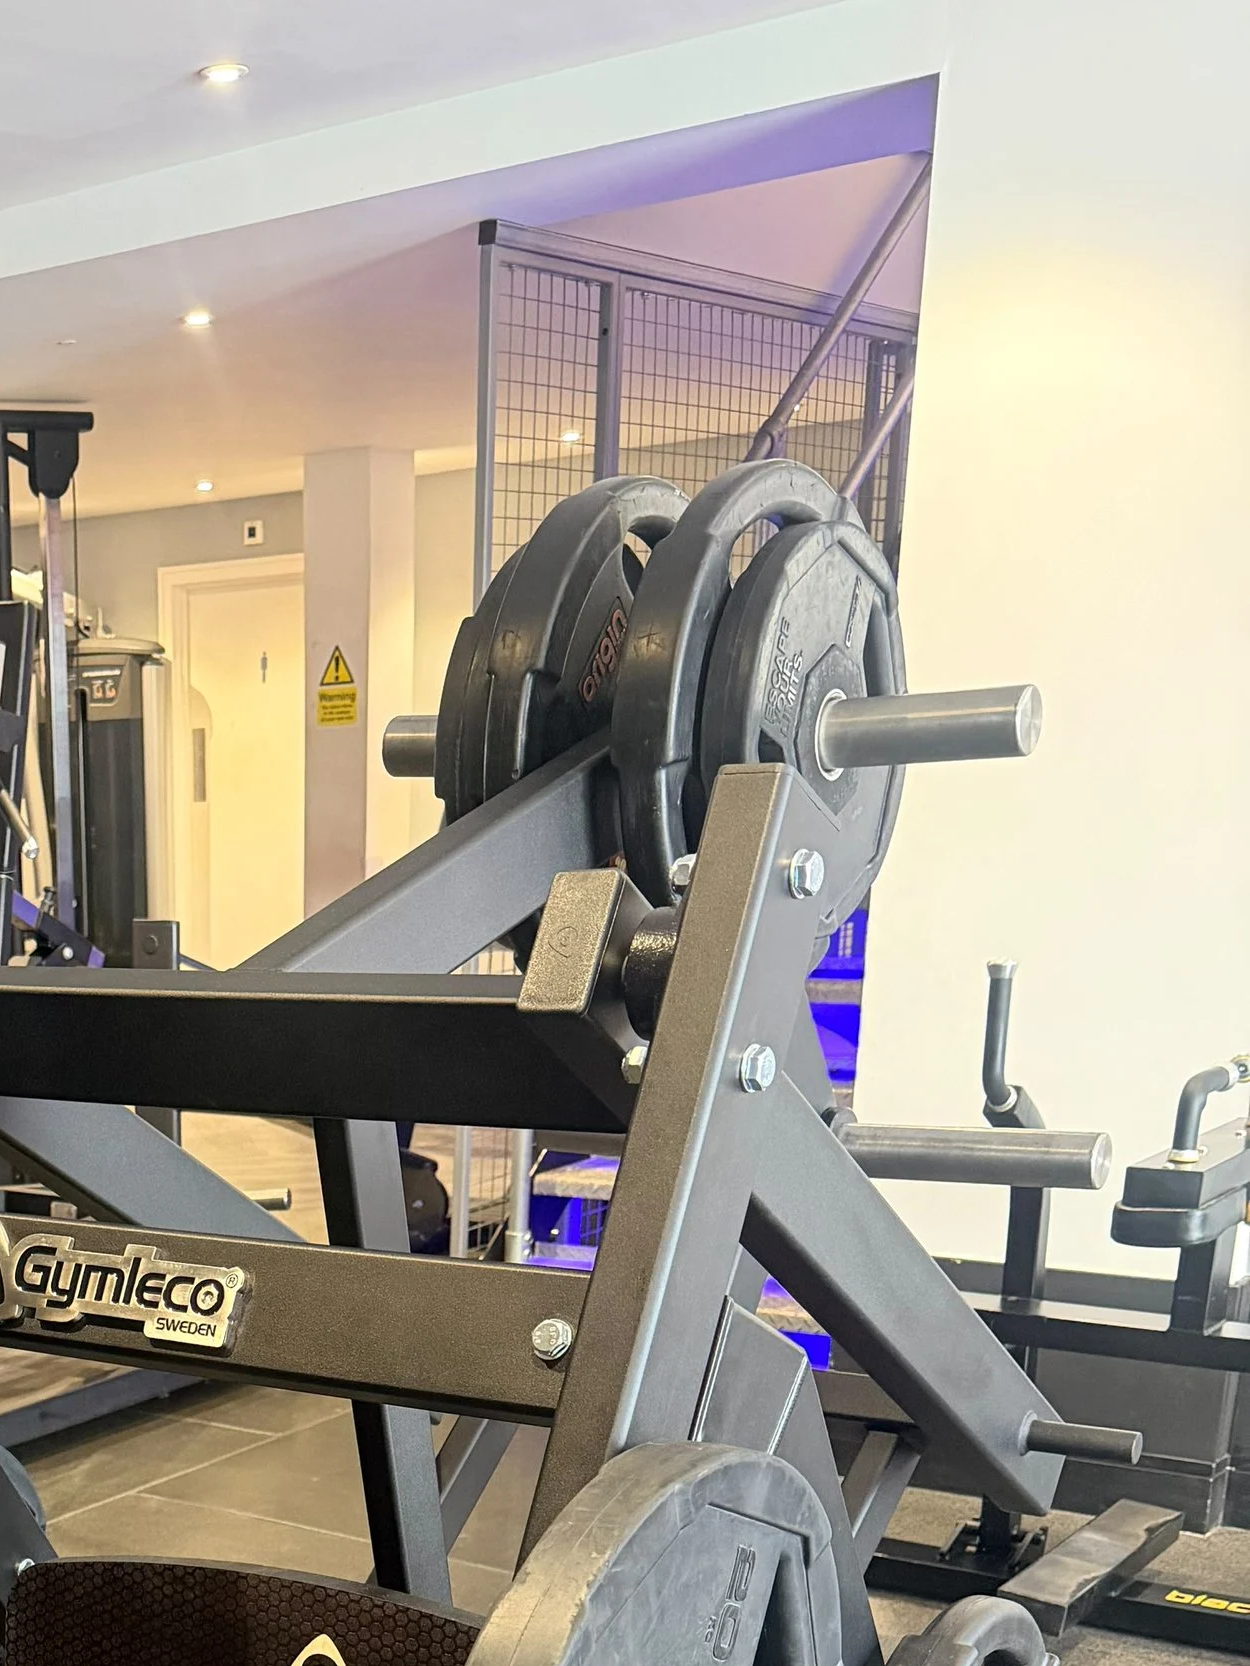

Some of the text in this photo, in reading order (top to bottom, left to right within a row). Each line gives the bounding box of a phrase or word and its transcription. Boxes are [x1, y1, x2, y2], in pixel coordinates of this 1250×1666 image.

[579, 608, 628, 702] origin
[765, 616, 790, 725] ESCAPE
[15, 1245, 225, 1317] Gymleco
[155, 1317, 217, 1338] SWEDEN
[712, 1544, 756, 1662] 20
